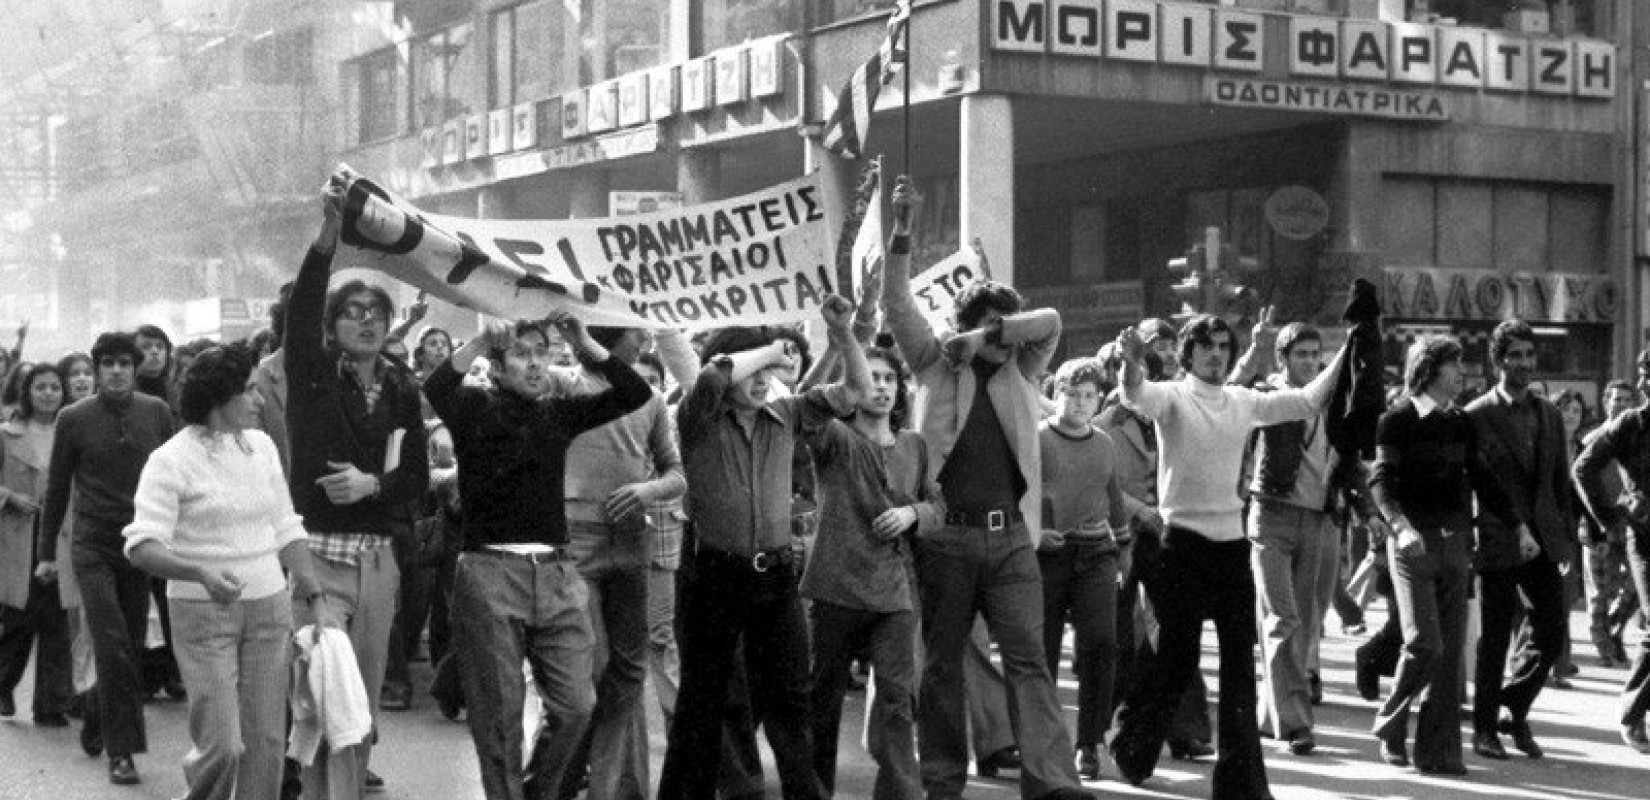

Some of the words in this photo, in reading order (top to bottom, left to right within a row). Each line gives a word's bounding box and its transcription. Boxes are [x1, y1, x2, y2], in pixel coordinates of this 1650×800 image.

[999, 1, 1257, 61] ΜΩΡΙΣ
[1298, 28, 1610, 89] ΦΑΡΑΤΖΗ
[1217, 80, 1444, 117] ΟΔΟΝΤΙΑΤΡΙΚΑ
[597, 185, 823, 262] ΓΡΑΜΜΑΤΕΙΣ
[613, 236, 786, 294] ΦΑΡΙΣΑΙΟΙ
[629, 265, 833, 323] ΥΠΟΚΡΙΤΑΙ
